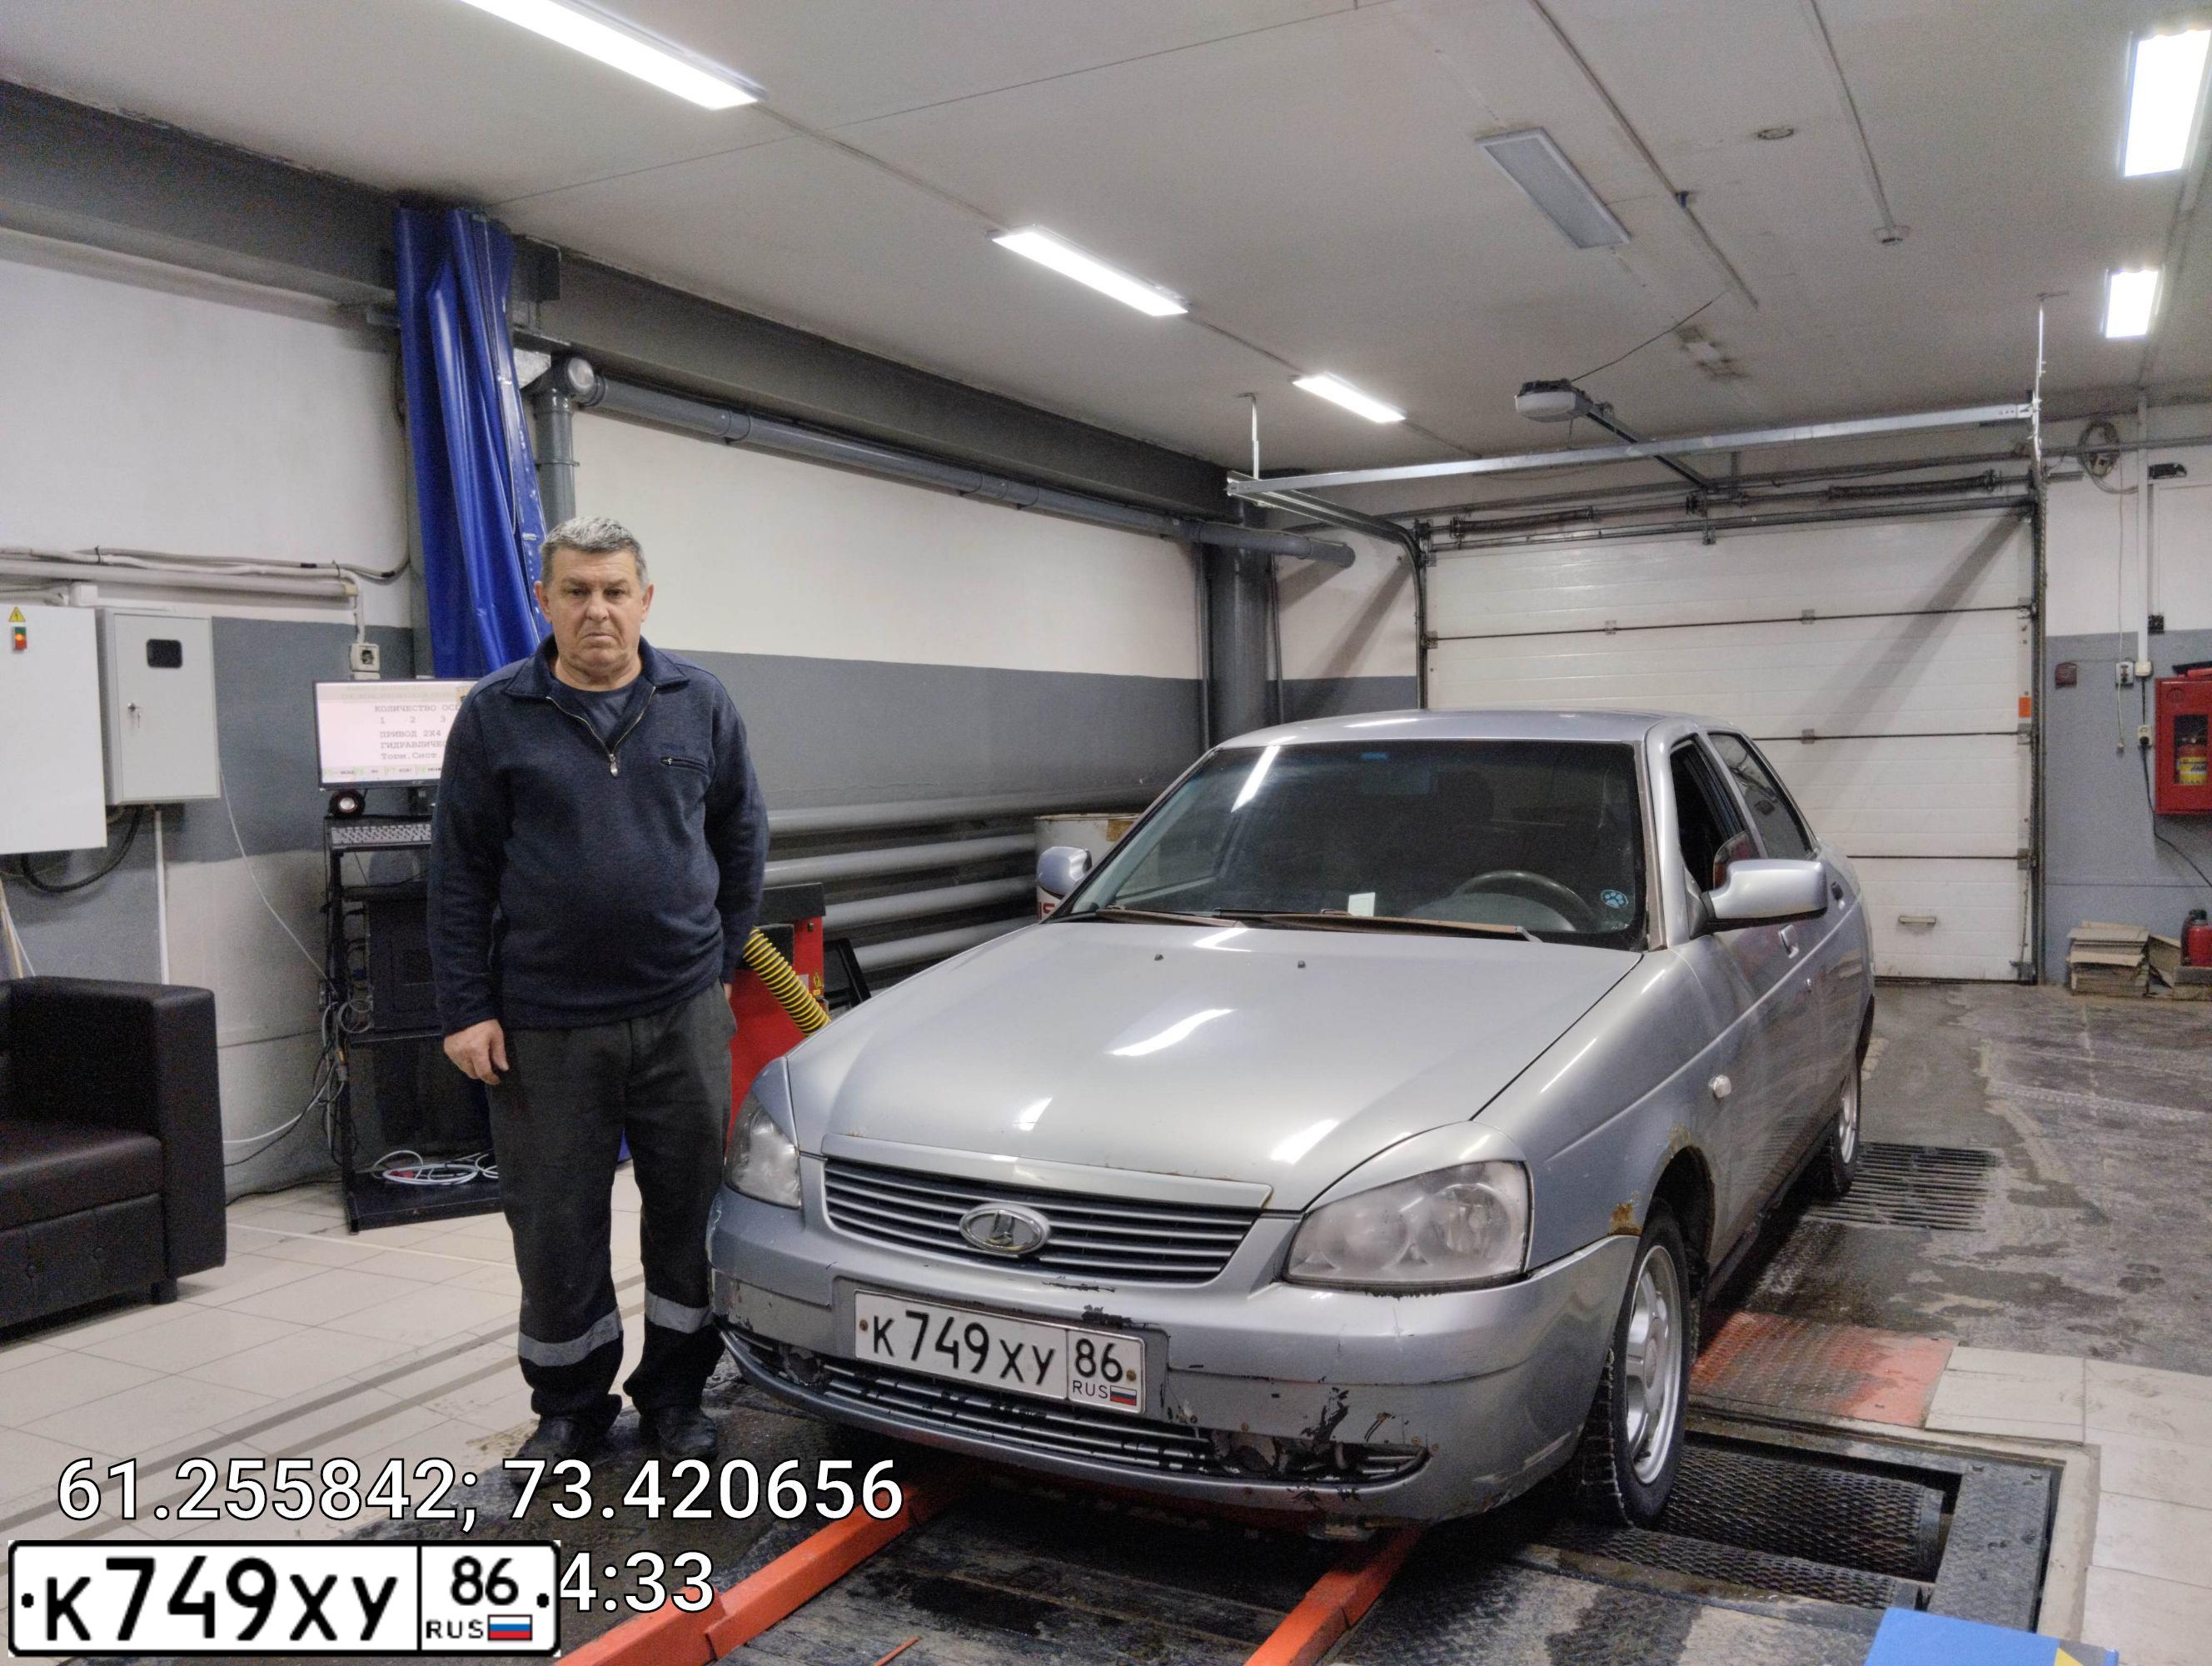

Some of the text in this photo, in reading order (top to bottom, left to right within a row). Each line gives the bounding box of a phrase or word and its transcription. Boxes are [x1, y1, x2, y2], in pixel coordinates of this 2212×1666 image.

[380, 730, 417, 739] ПРИВОД
[1074, 1338, 1123, 1383] 86
[1072, 1379, 1108, 1399] RUS
